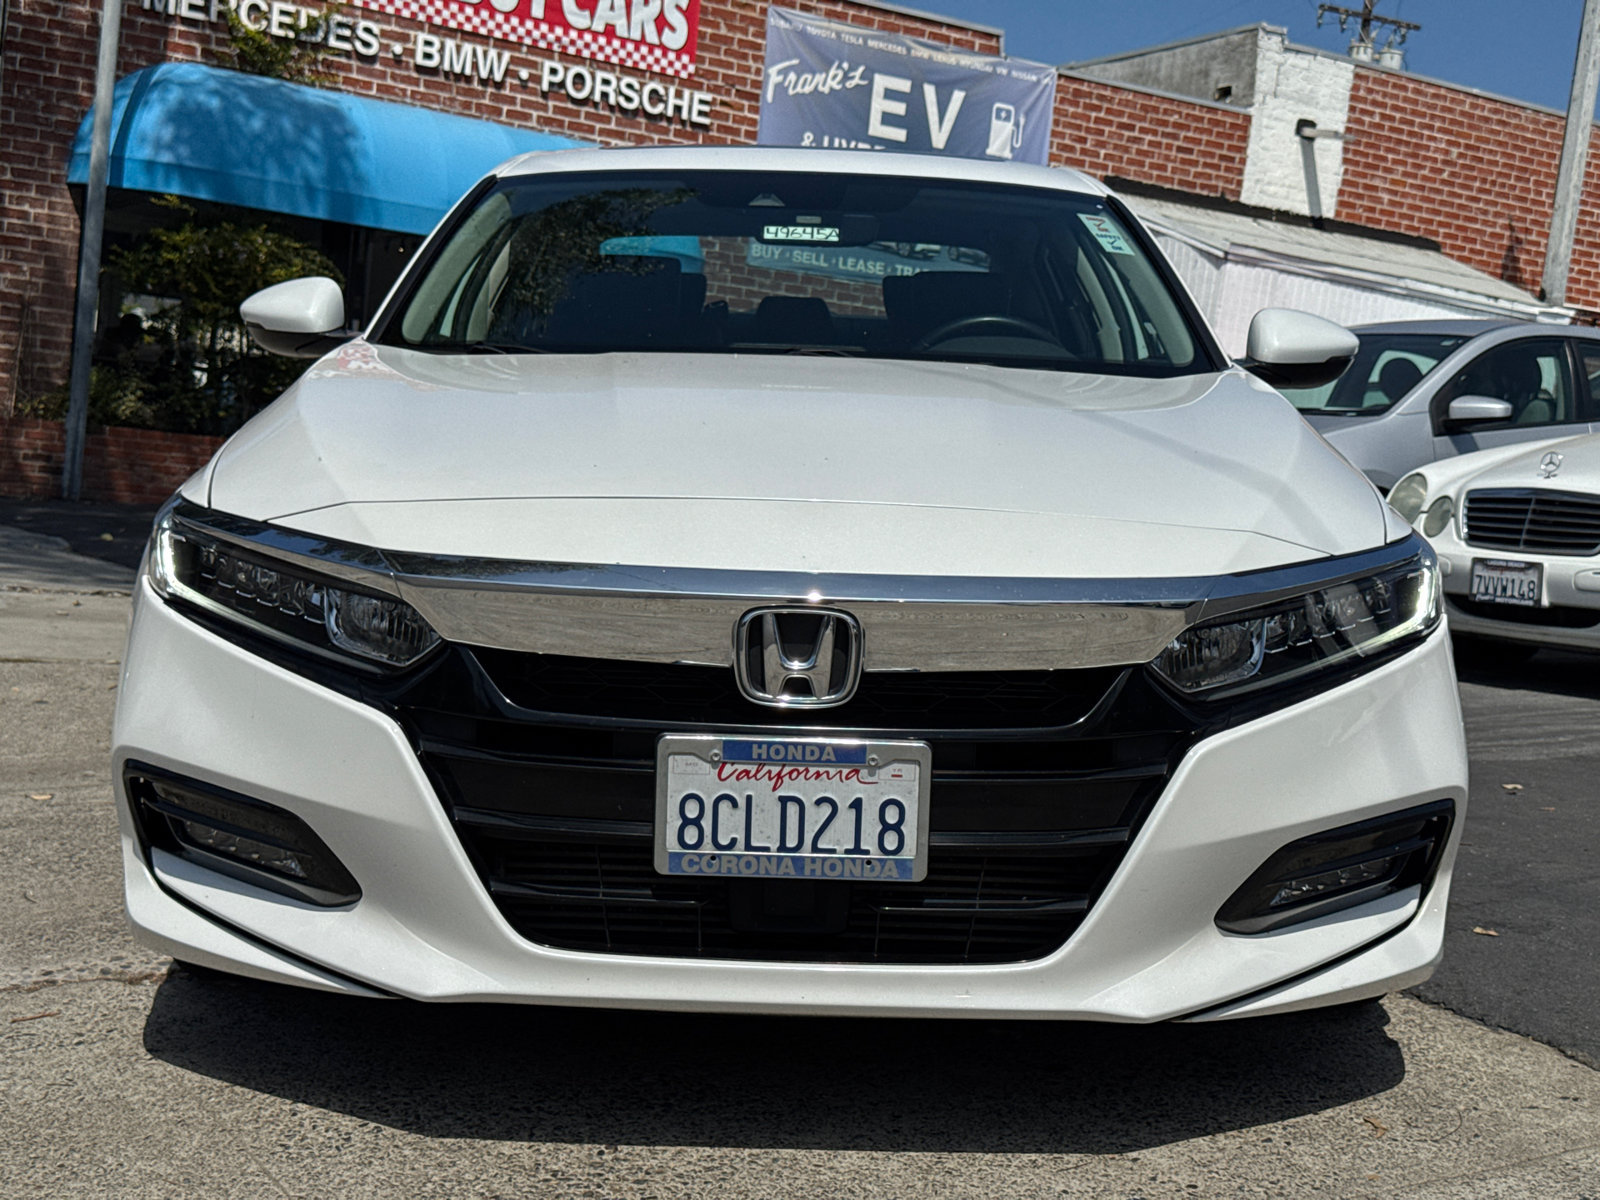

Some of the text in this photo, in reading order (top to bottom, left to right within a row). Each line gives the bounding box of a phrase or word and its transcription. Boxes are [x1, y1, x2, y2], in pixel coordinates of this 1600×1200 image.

[562, 0, 691, 50] CARS
[806, 25, 837, 40] TOYOTA
[841, 33, 864, 46] TESLA
[867, 38, 907, 55] MERCEDES
[415, 33, 510, 83] BMW
[541, 61, 713, 125] PORSCHE
[766, 59, 869, 103] Frank's
[868, 73, 966, 149] EV
[766, 228, 839, 240] 49645A
[751, 245, 783, 259] BUY
[793, 250, 828, 267] SELL
[838, 257, 885, 275] LEASE
[752, 744, 836, 762] HONDA
[717, 761, 879, 793] California
[677, 792, 906, 857] 8CLD218
[681, 853, 899, 879] CORONA HONDA
